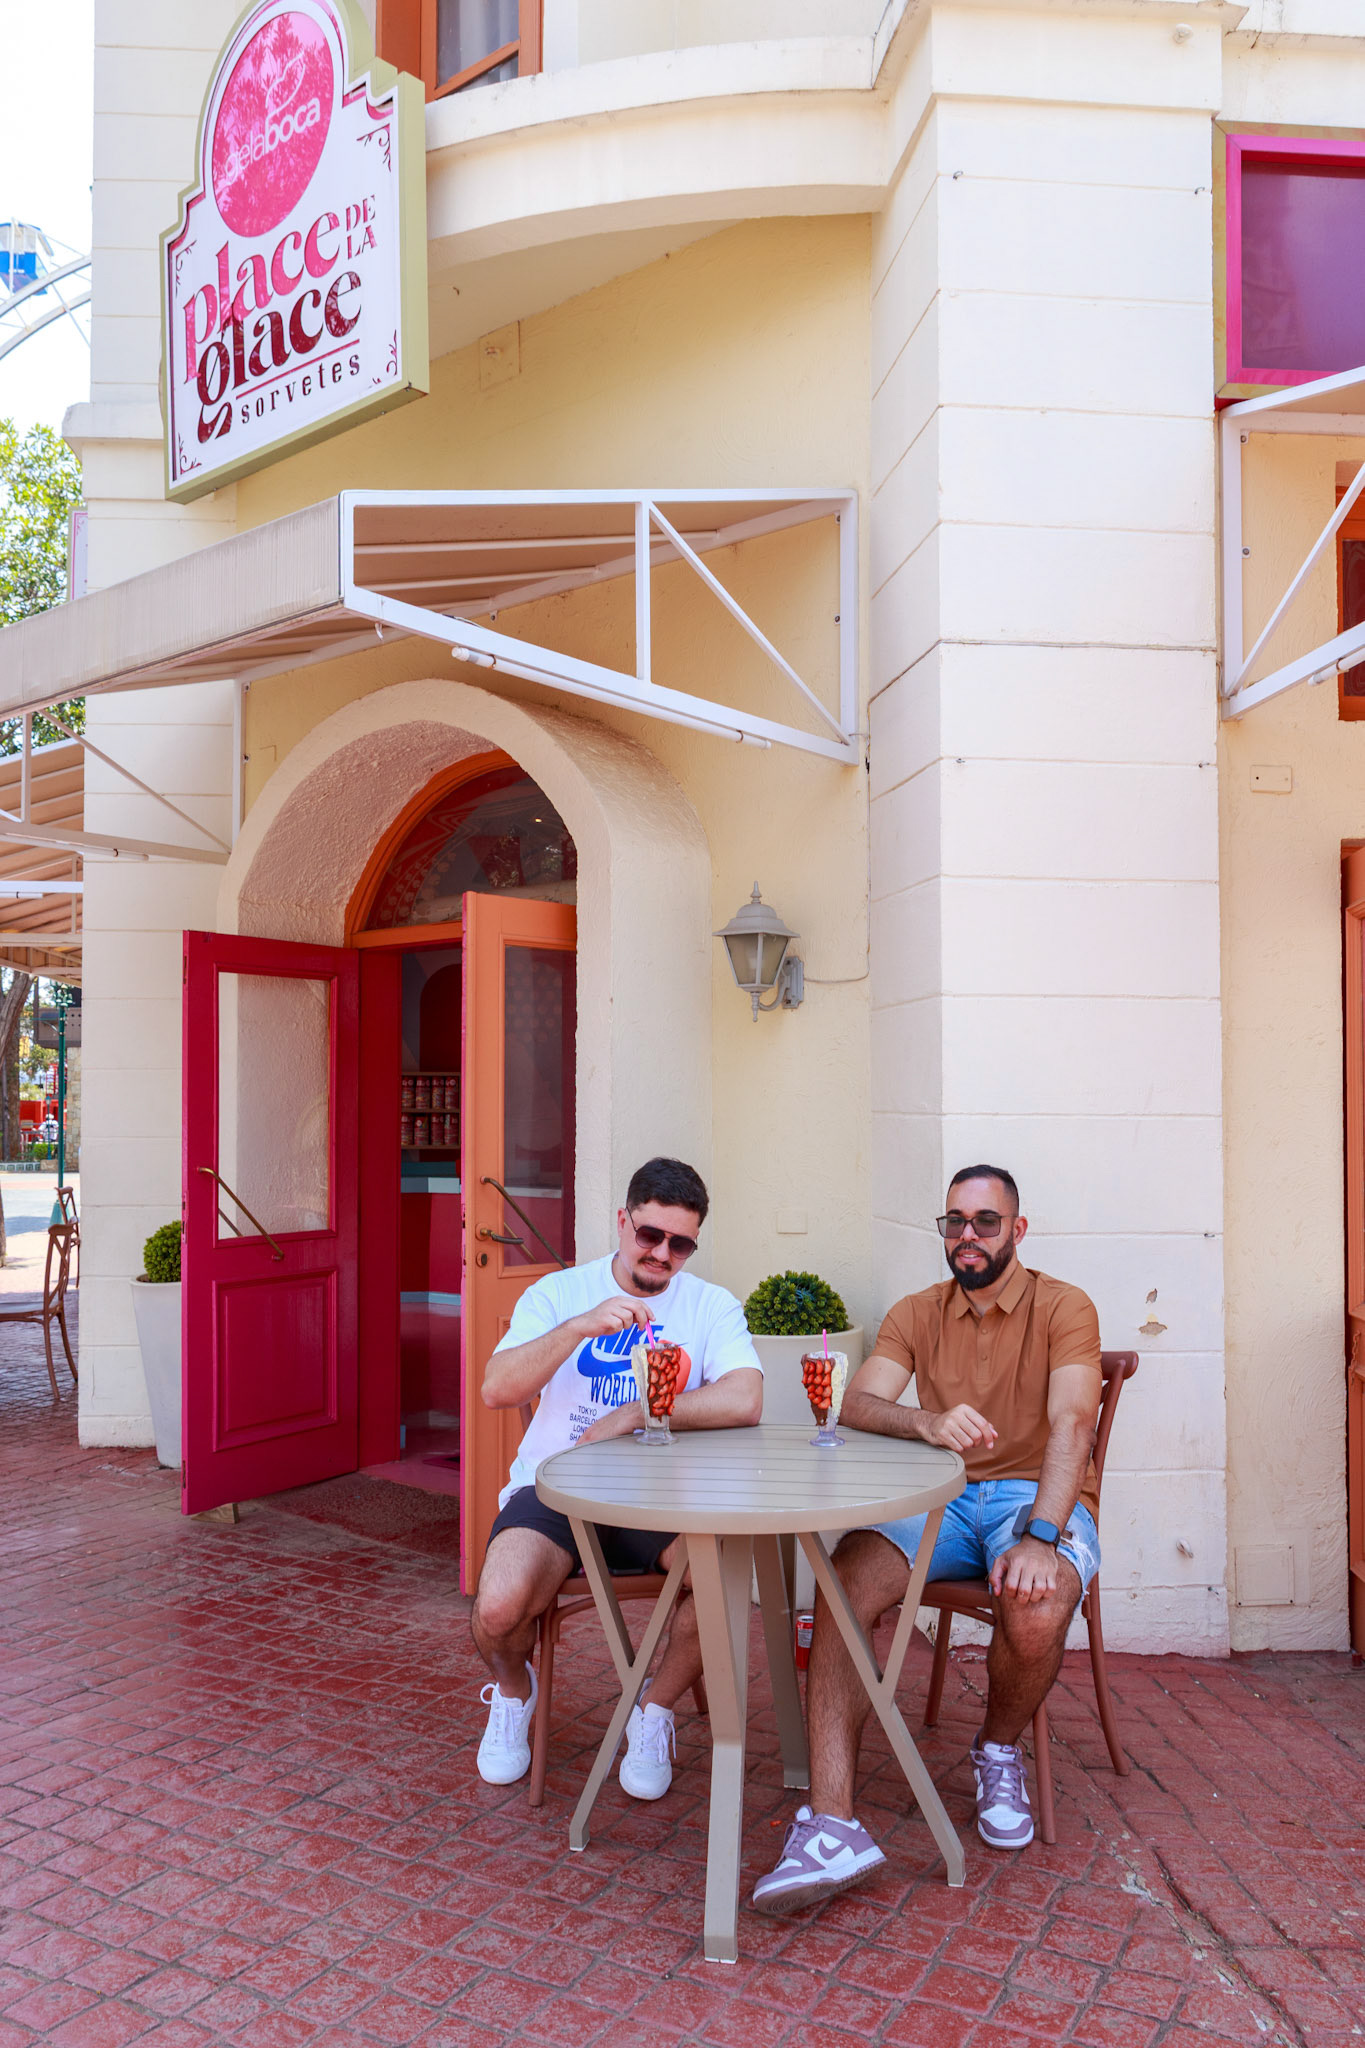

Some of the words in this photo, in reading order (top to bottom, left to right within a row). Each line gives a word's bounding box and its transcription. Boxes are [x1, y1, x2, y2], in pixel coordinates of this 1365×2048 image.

[225, 97, 320, 186] gelaboca
[346, 194, 376, 232] DE
[347, 225, 378, 260] LA
[184, 211, 341, 385] place
[197, 270, 362, 443] glace
[241, 354, 360, 424] sorvetes
[569, 1412, 598, 1426] BARCELO
[578, 1405, 598, 1417] TOKYO
